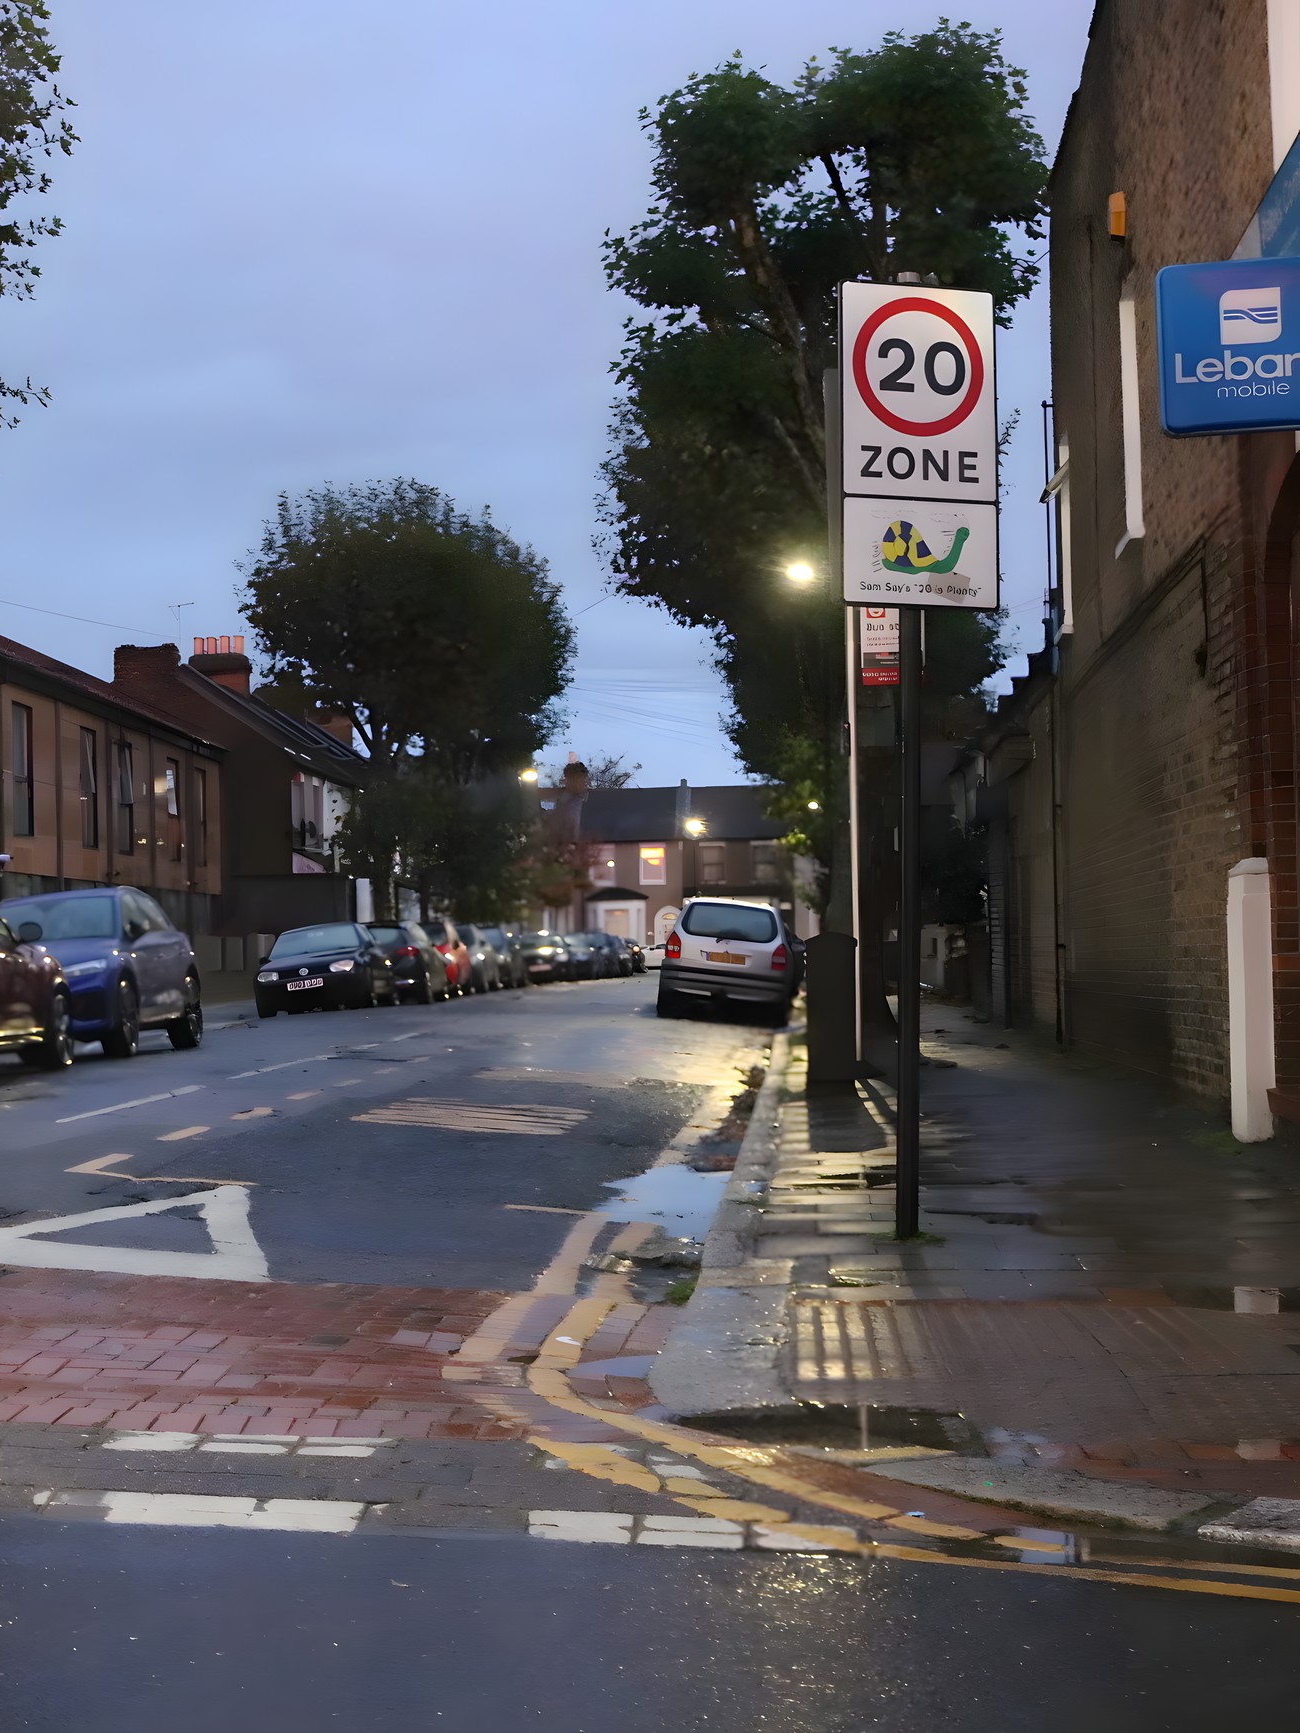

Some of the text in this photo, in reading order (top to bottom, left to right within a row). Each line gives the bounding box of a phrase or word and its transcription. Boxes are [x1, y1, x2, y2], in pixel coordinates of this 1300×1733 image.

[877, 337, 966, 396] 20
[1217, 380, 1291, 398] mobile
[860, 444, 980, 484] ZONE
